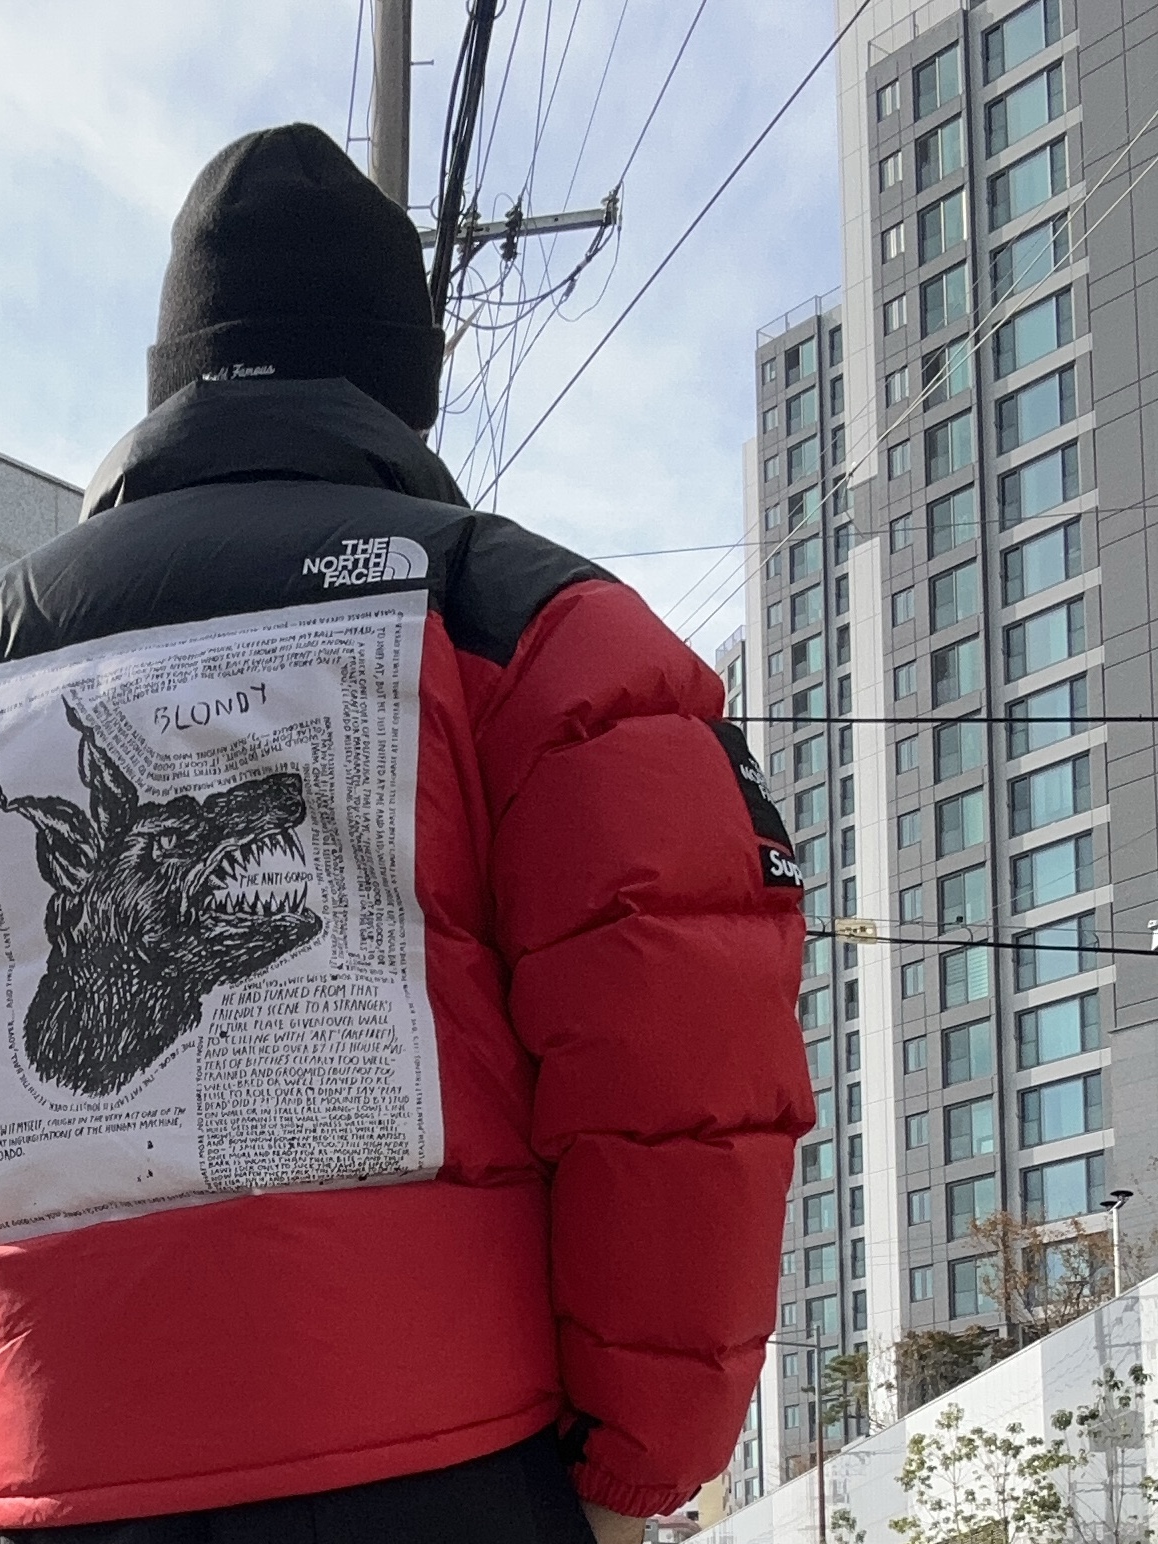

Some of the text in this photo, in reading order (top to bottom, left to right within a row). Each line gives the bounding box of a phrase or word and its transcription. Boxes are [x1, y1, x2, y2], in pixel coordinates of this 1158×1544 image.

[342, 537, 389, 556] THE
[302, 551, 387, 575] NORTH
[323, 567, 384, 588] FACE
[154, 682, 267, 735] BLONDY
